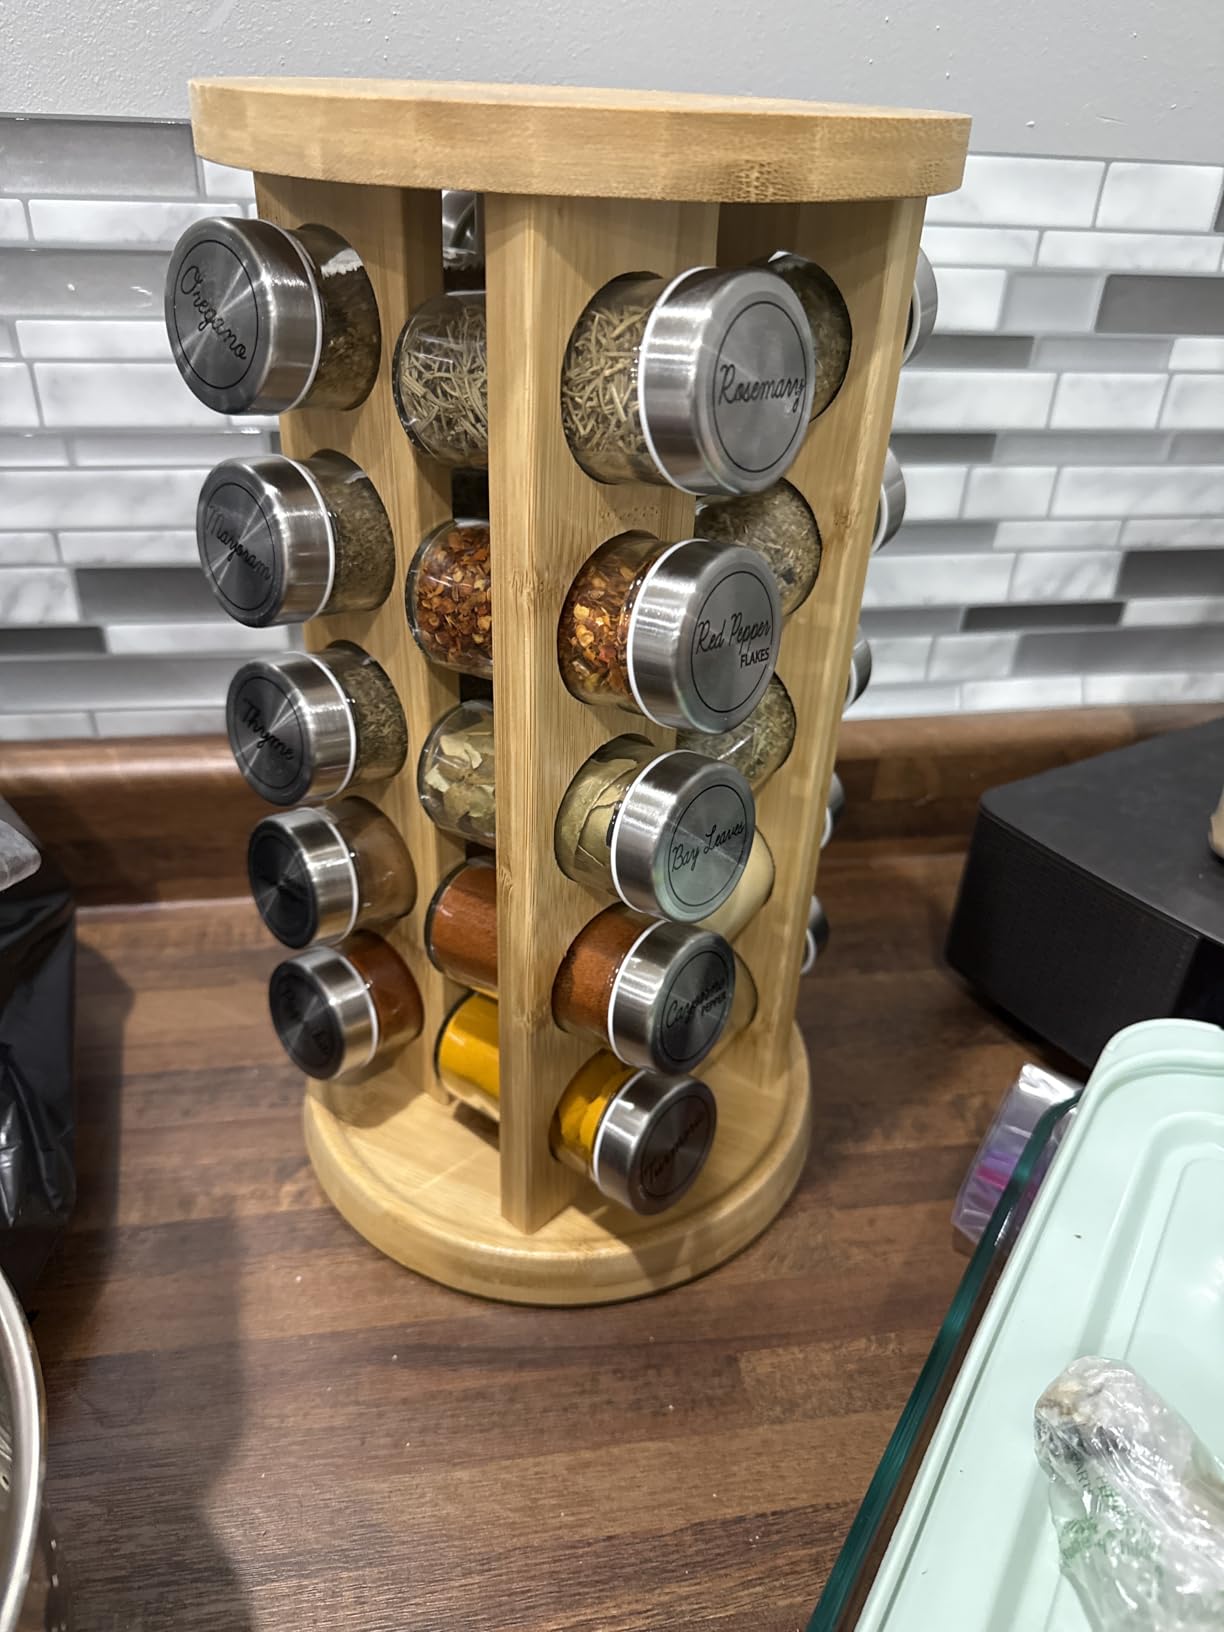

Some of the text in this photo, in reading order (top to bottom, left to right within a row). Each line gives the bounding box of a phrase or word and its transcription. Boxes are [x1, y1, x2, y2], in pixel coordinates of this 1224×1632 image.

[181, 265, 248, 360] Oregano
[719, 363, 806, 413] Rosemary
[695, 611, 771, 655] Red Pepper
[740, 647, 770, 668] FLAKES
[672, 843, 700, 872] Bay
